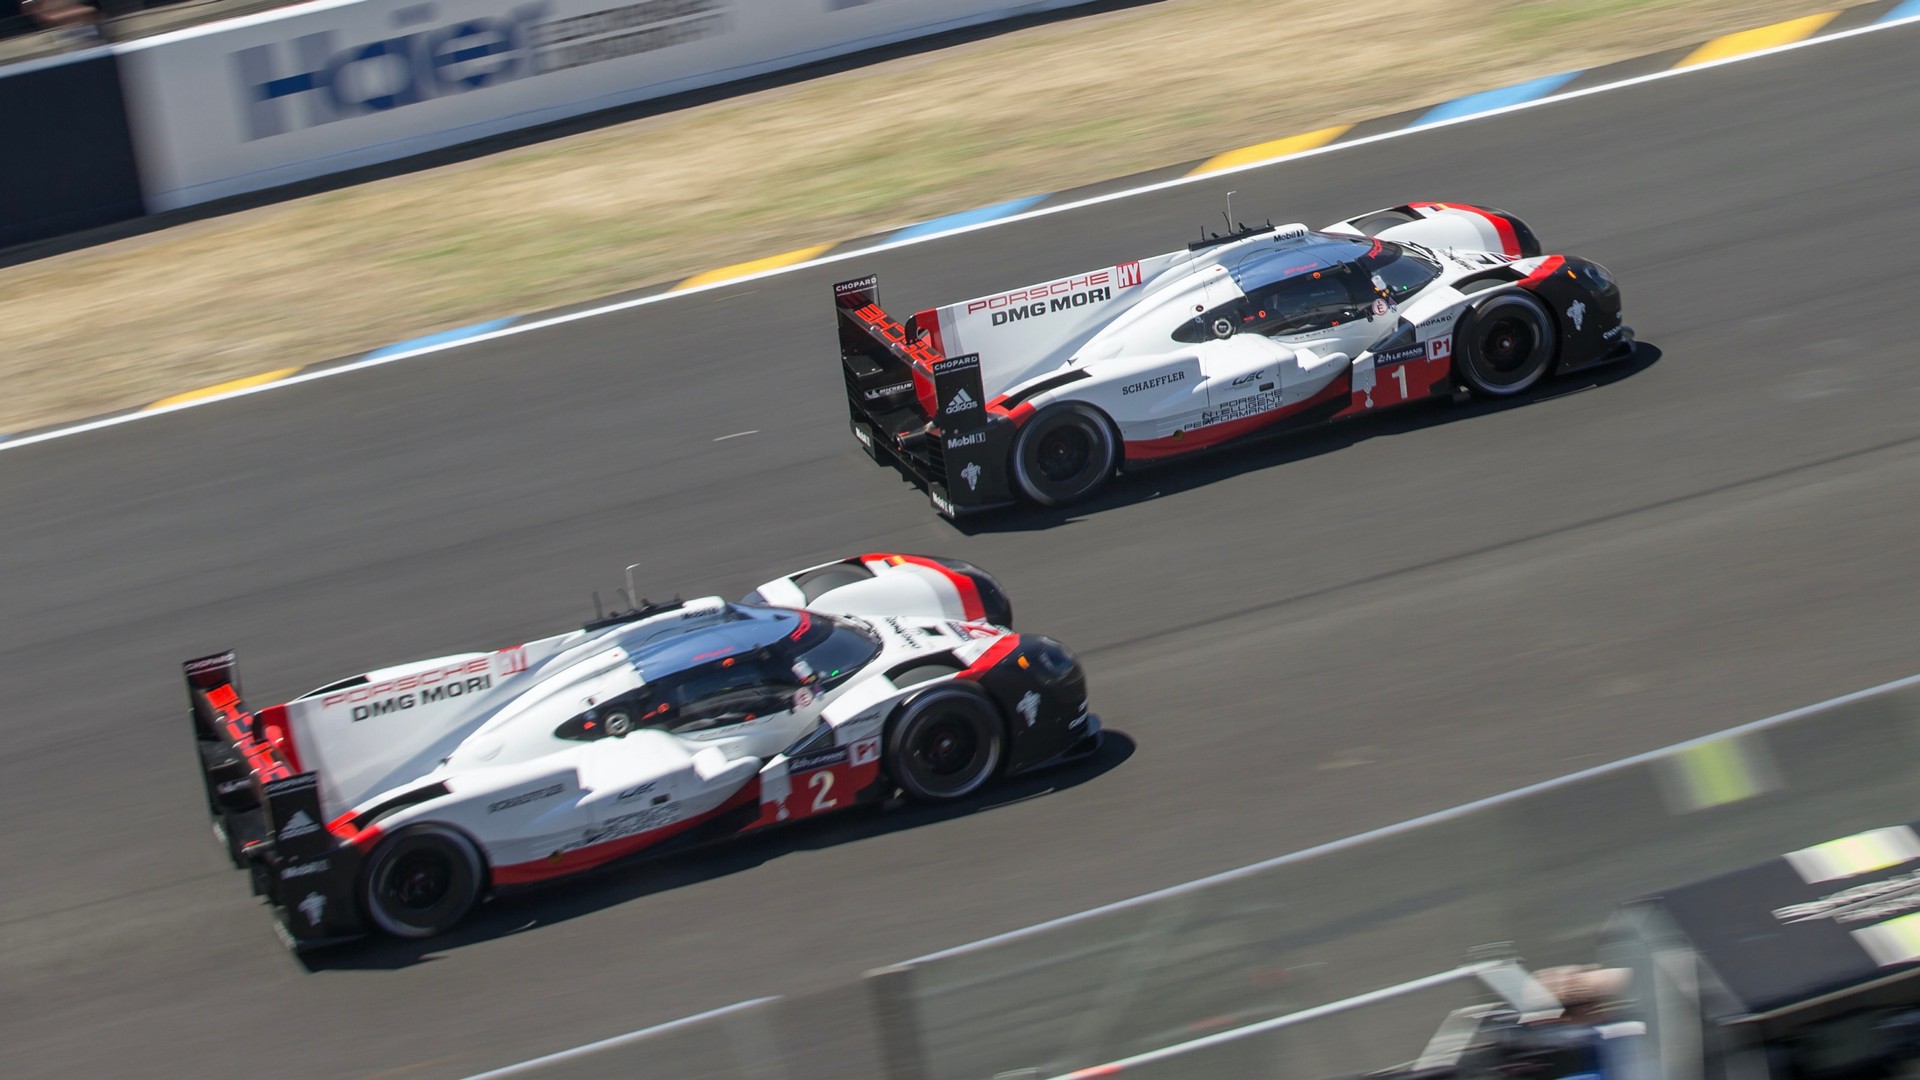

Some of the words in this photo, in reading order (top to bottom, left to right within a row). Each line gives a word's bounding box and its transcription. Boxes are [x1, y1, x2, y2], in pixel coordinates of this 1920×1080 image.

[1274, 231, 1296, 243] Mobil
[836, 277, 877, 292] CHOPARD
[1118, 263, 1140, 288] HY
[968, 272, 1109, 314] PORSCHE
[991, 302, 1046, 327] DMG
[1050, 287, 1110, 313] MORI
[1416, 314, 1451, 329] CHOPARD
[1432, 338, 1450, 356] P1
[934, 356, 978, 371] CHOPARD
[1122, 371, 1185, 395] SCHAEFFLER
[1232, 370, 1264, 386] WEC
[1392, 365, 1408, 399] 1
[879, 383, 912, 395] MICHELIN
[946, 400, 978, 414] adidas
[1201, 395, 1282, 419] NTELLIGENT
[1220, 389, 1282, 409] PORSCHE
[948, 434, 975, 449] Mobil
[322, 658, 490, 708] PORSCHE
[352, 694, 415, 723] DMG
[420, 674, 492, 705] MORI
[856, 740, 877, 759] P1
[808, 770, 837, 813] 2
